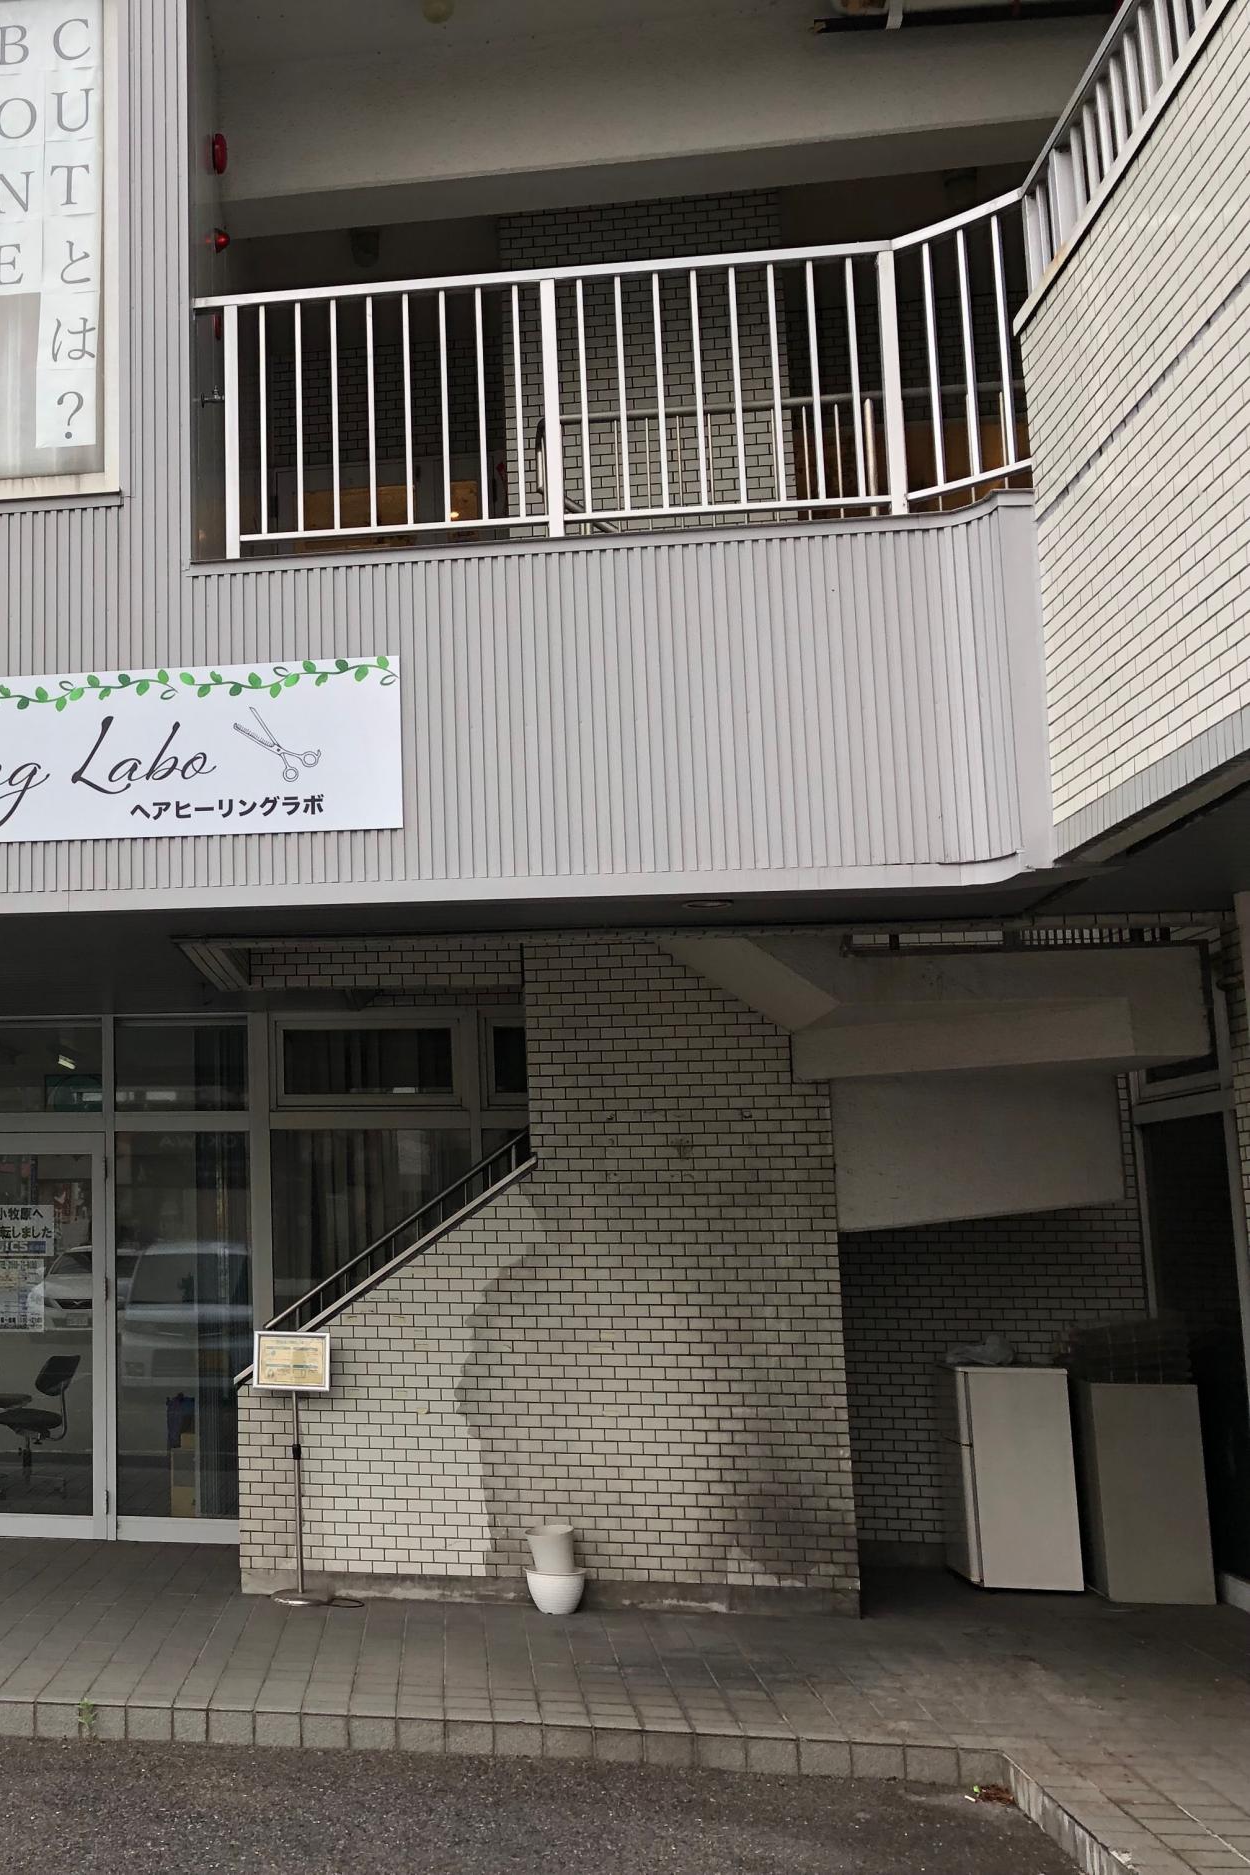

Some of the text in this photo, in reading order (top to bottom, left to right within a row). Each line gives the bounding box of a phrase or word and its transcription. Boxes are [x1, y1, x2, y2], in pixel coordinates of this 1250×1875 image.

[71, 715, 217, 794] Labo
[130, 794, 325, 819] ヘアヒーリングラボ
